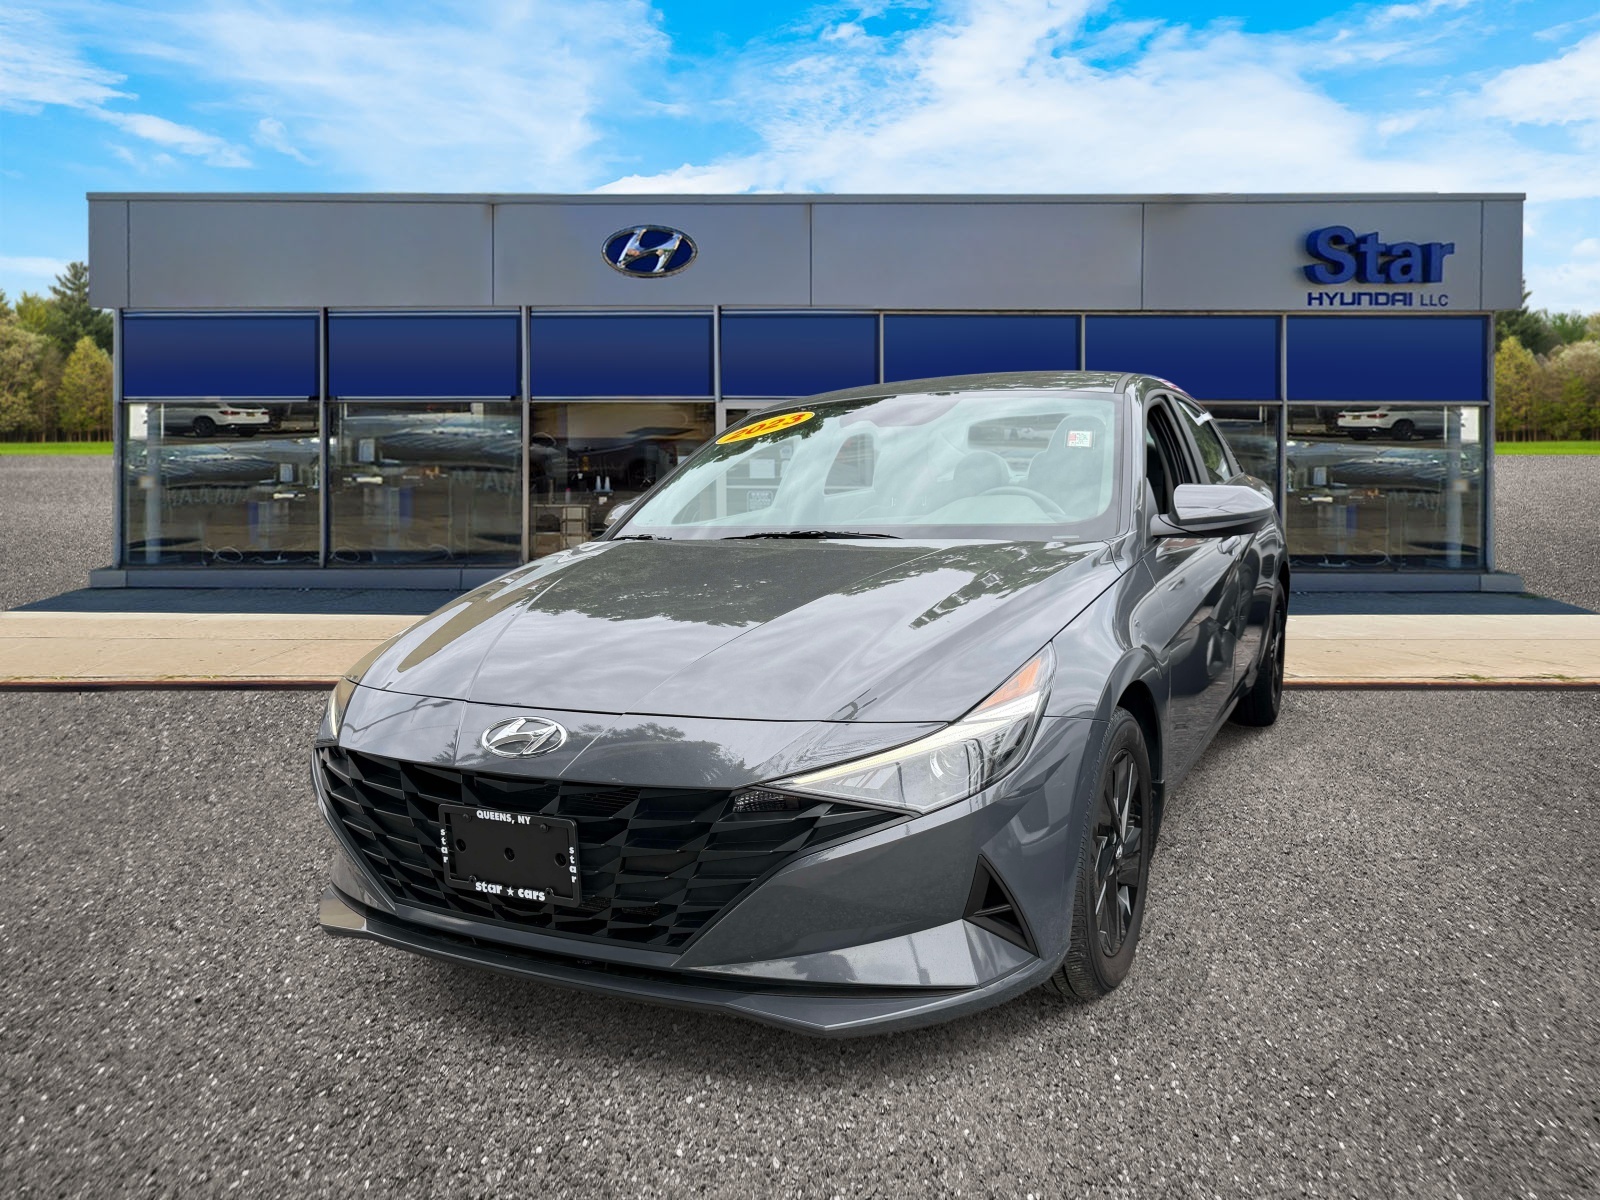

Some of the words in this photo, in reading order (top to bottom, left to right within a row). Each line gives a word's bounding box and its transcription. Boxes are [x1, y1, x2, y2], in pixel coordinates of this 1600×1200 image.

[1303, 225, 1455, 285] Star
[1307, 292, 1413, 306] HYUNDAI
[1420, 294, 1449, 306] LLC
[724, 413, 807, 441] 2023
[476, 810, 515, 825] QUEENS,
[517, 815, 532, 825] NY
[475, 881, 502, 895] star
[517, 888, 546, 901] cars
